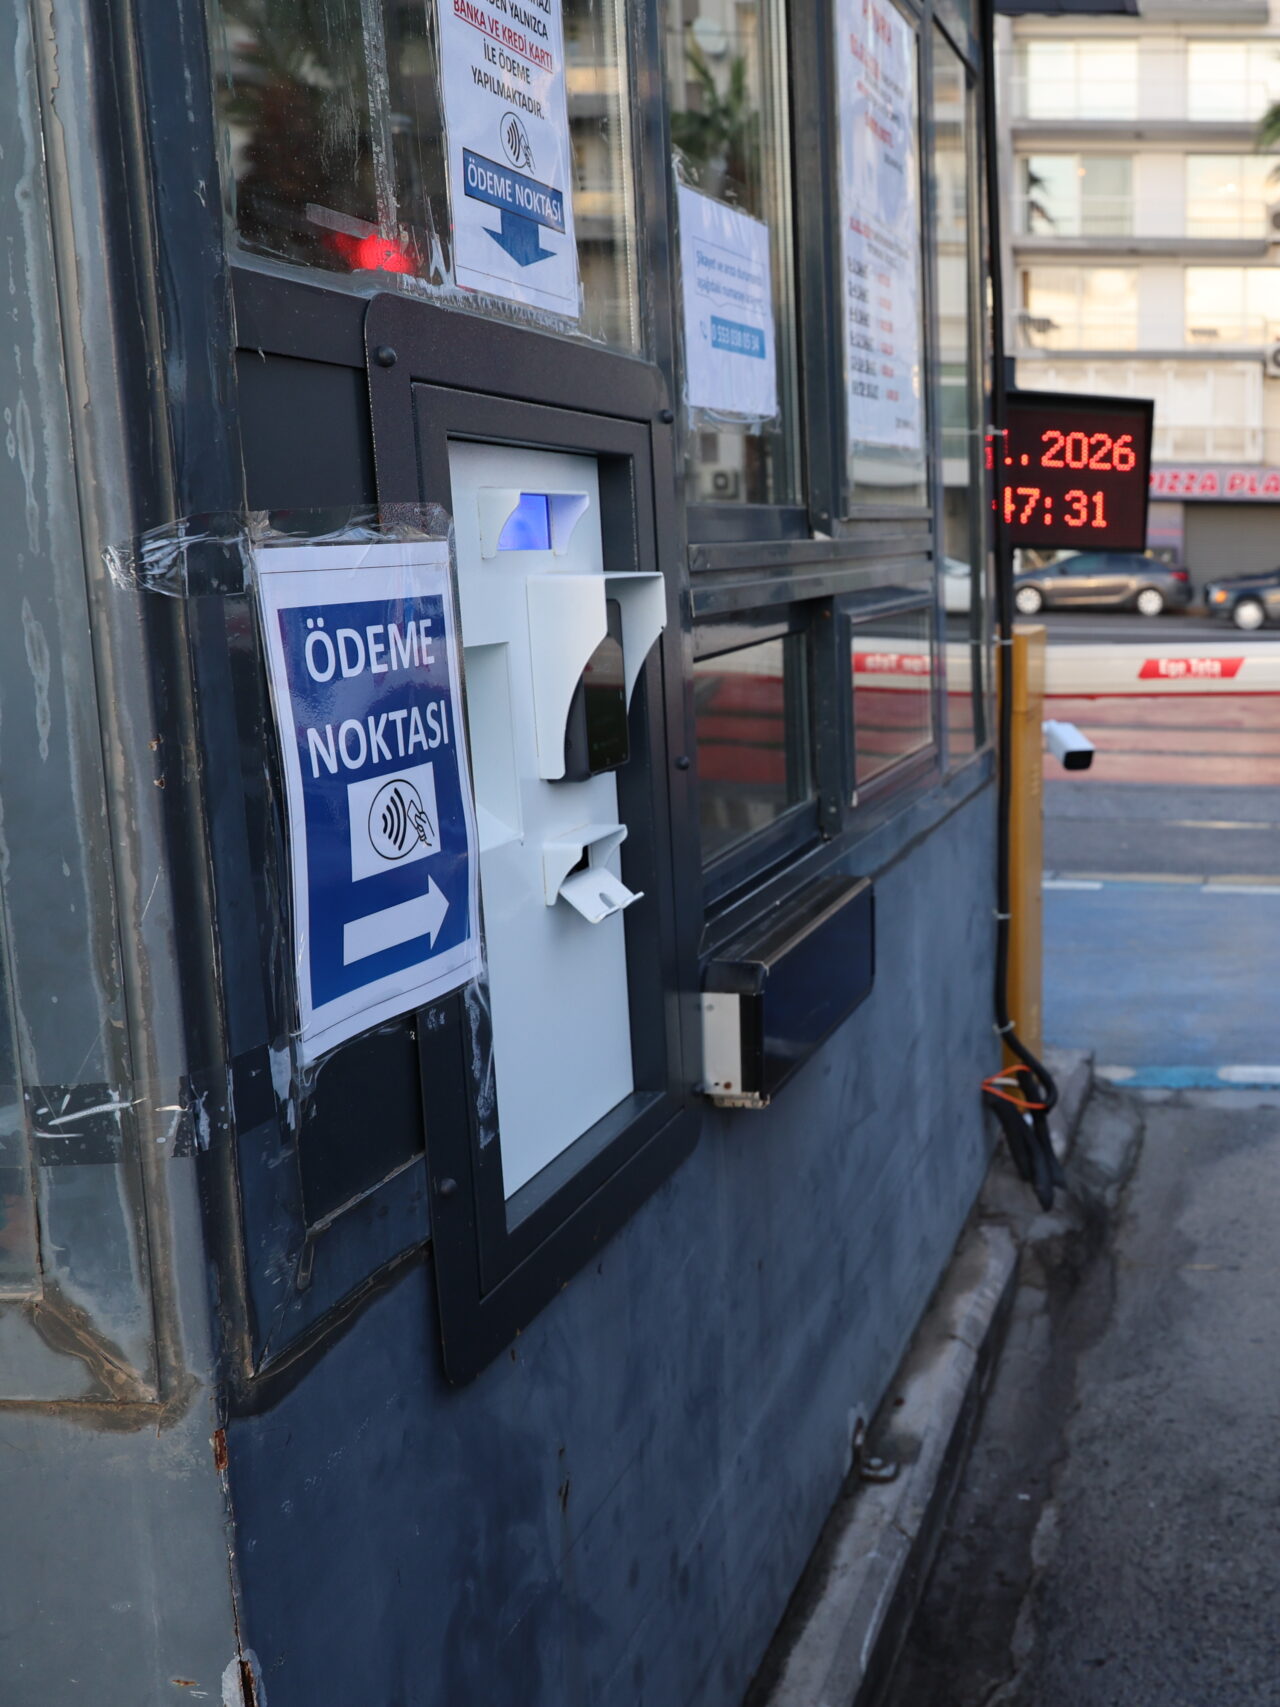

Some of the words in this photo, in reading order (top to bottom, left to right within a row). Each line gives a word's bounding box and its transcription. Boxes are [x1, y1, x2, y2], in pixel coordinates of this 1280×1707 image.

[453, 0, 487, 29] BANKA
[488, 16, 500, 37] VE
[502, 24, 527, 54] KREDİ
[529, 42, 552, 70] KARTI
[509, 1, 548, 40] YALNIZCA
[484, 38, 497, 65] İLE
[499, 48, 530, 85] ÖDEME
[471, 65, 544, 120] YAPILMAKTADIR.
[468, 157, 512, 202] ÖDEME
[515, 183, 561, 222] NOKTASI
[1041, 430, 1136, 472] 2026
[1149, 472, 1219, 493] IZZA
[304, 617, 435, 683] ÖDEME
[306, 699, 449, 779] NOKTASI
